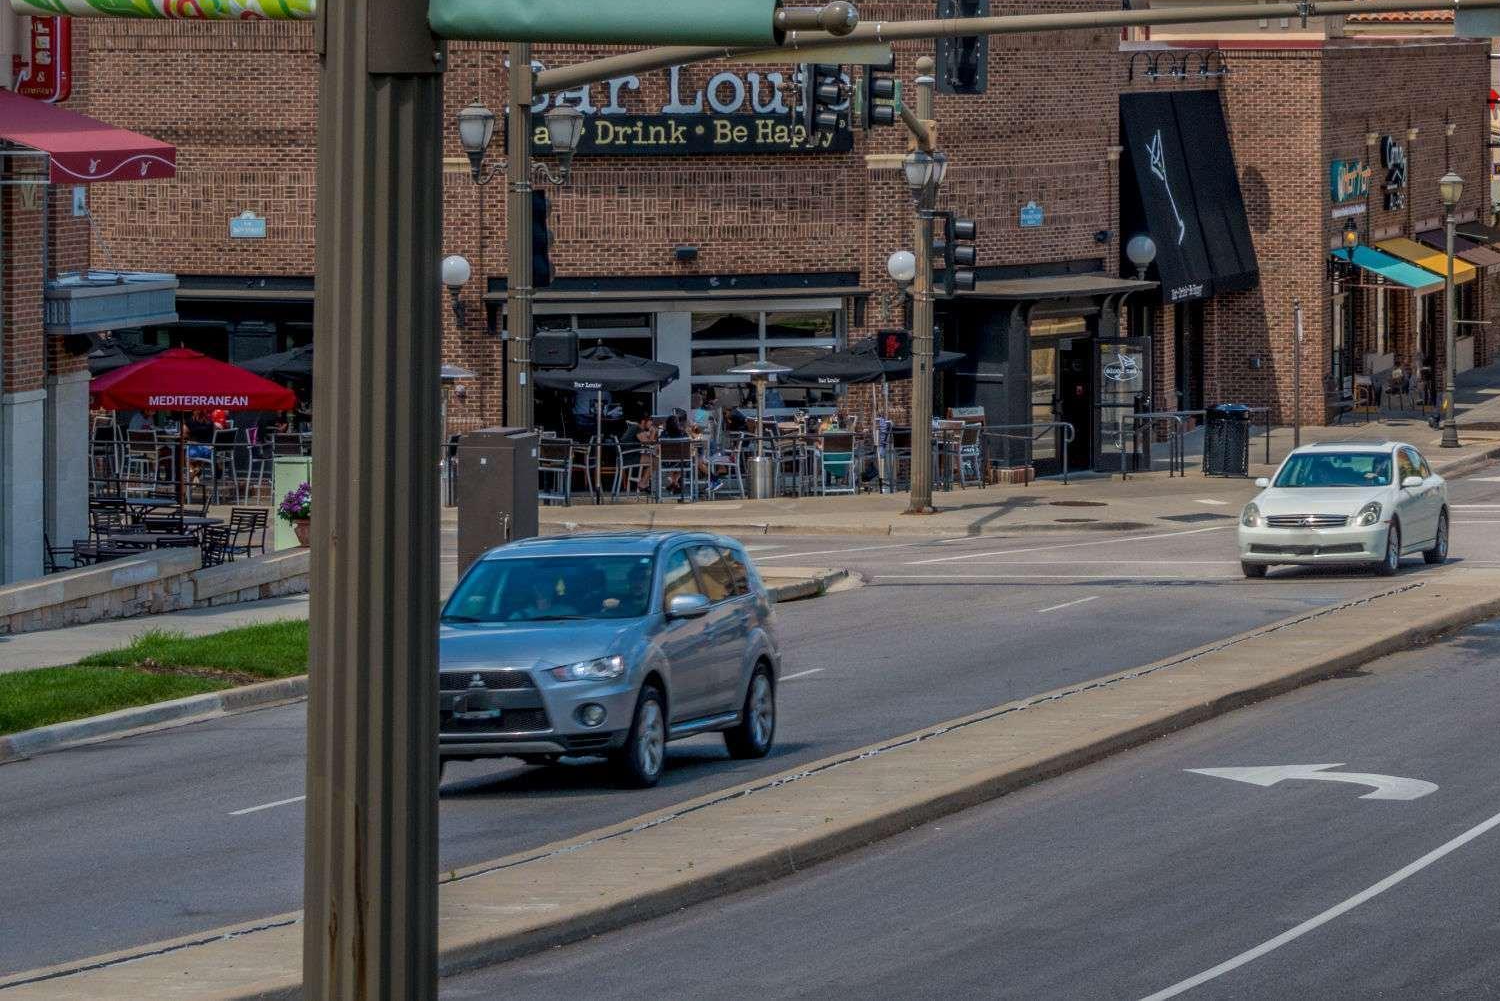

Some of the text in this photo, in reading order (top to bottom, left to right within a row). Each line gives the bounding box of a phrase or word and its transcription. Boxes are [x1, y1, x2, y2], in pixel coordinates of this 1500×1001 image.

[594, 119, 688, 146] Drink
[713, 119, 748, 145] Be
[149, 395, 249, 406] MEDITERRANEAN
